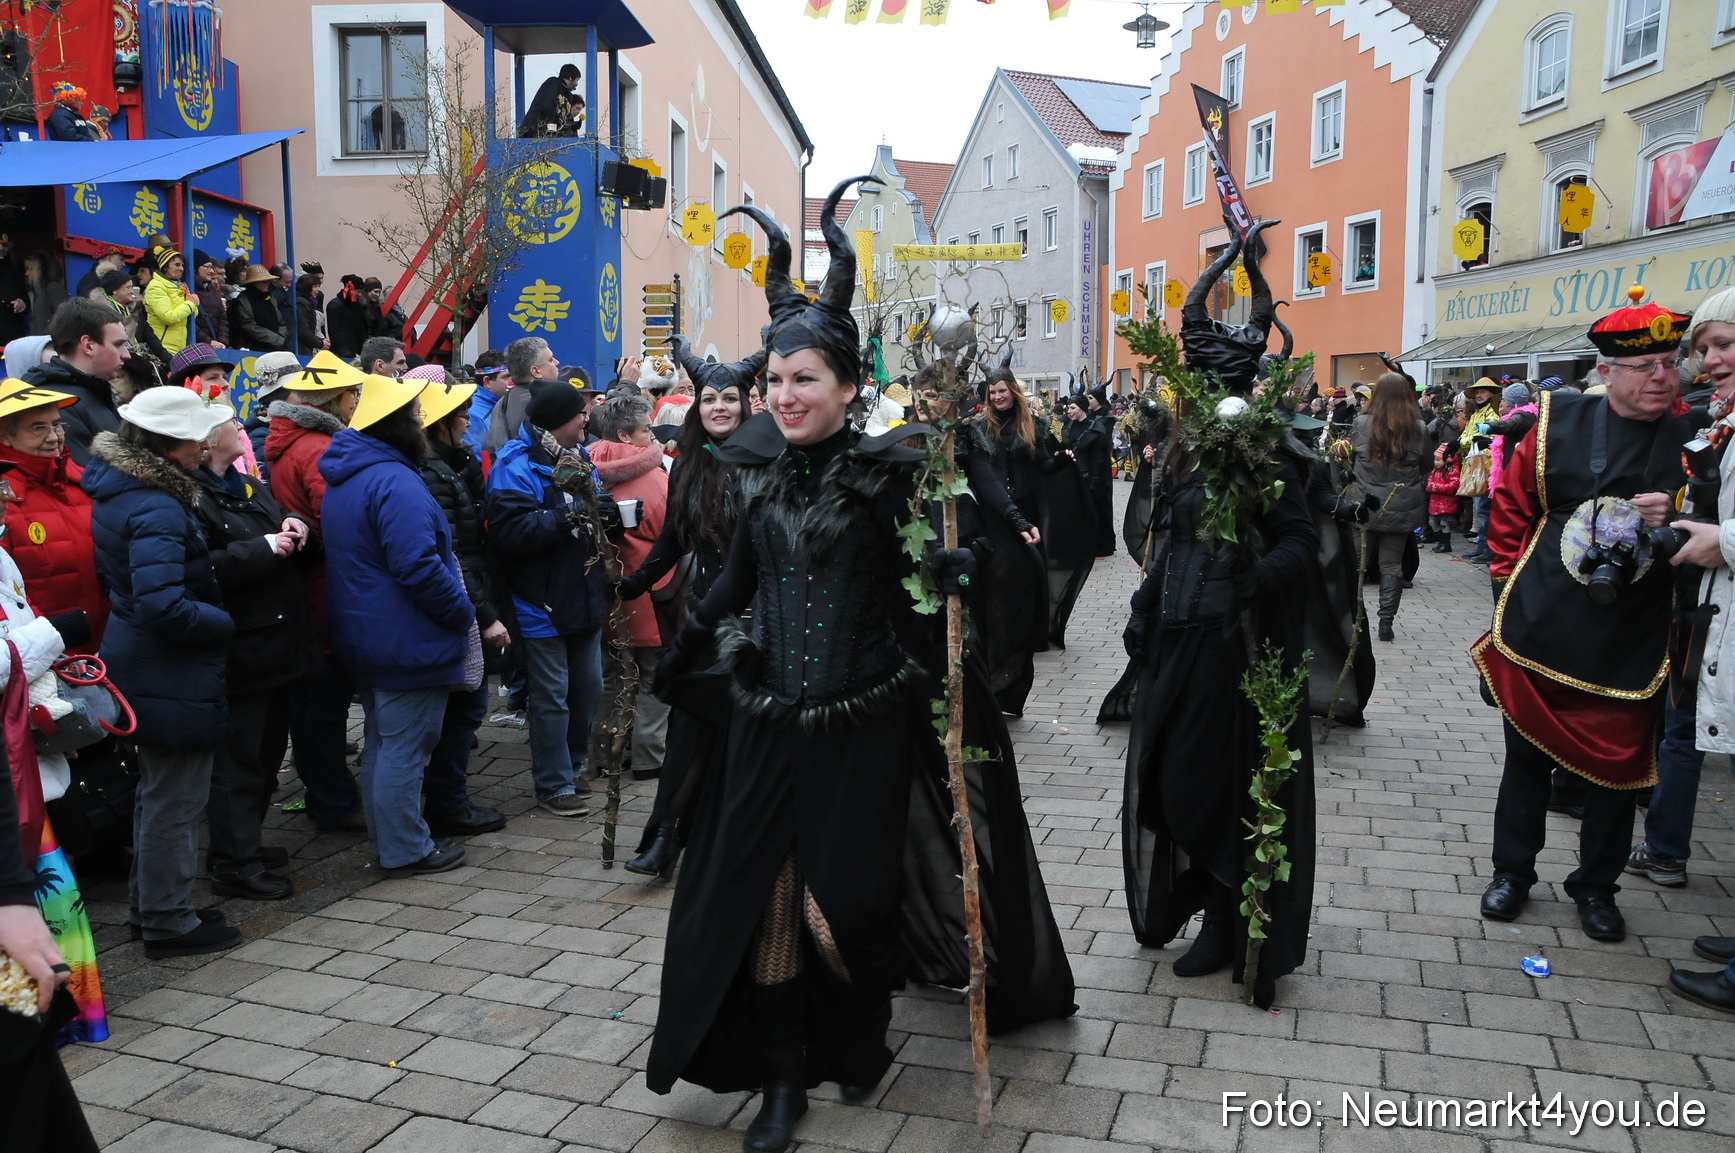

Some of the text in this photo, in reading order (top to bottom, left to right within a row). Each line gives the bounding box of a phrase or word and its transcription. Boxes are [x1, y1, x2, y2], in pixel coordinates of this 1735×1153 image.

[1701, 184, 1735, 200] NEUERÖ
[1081, 221, 1091, 356] UHREN SCHMUCK
[1446, 287, 1531, 322] BÄCKEREI
